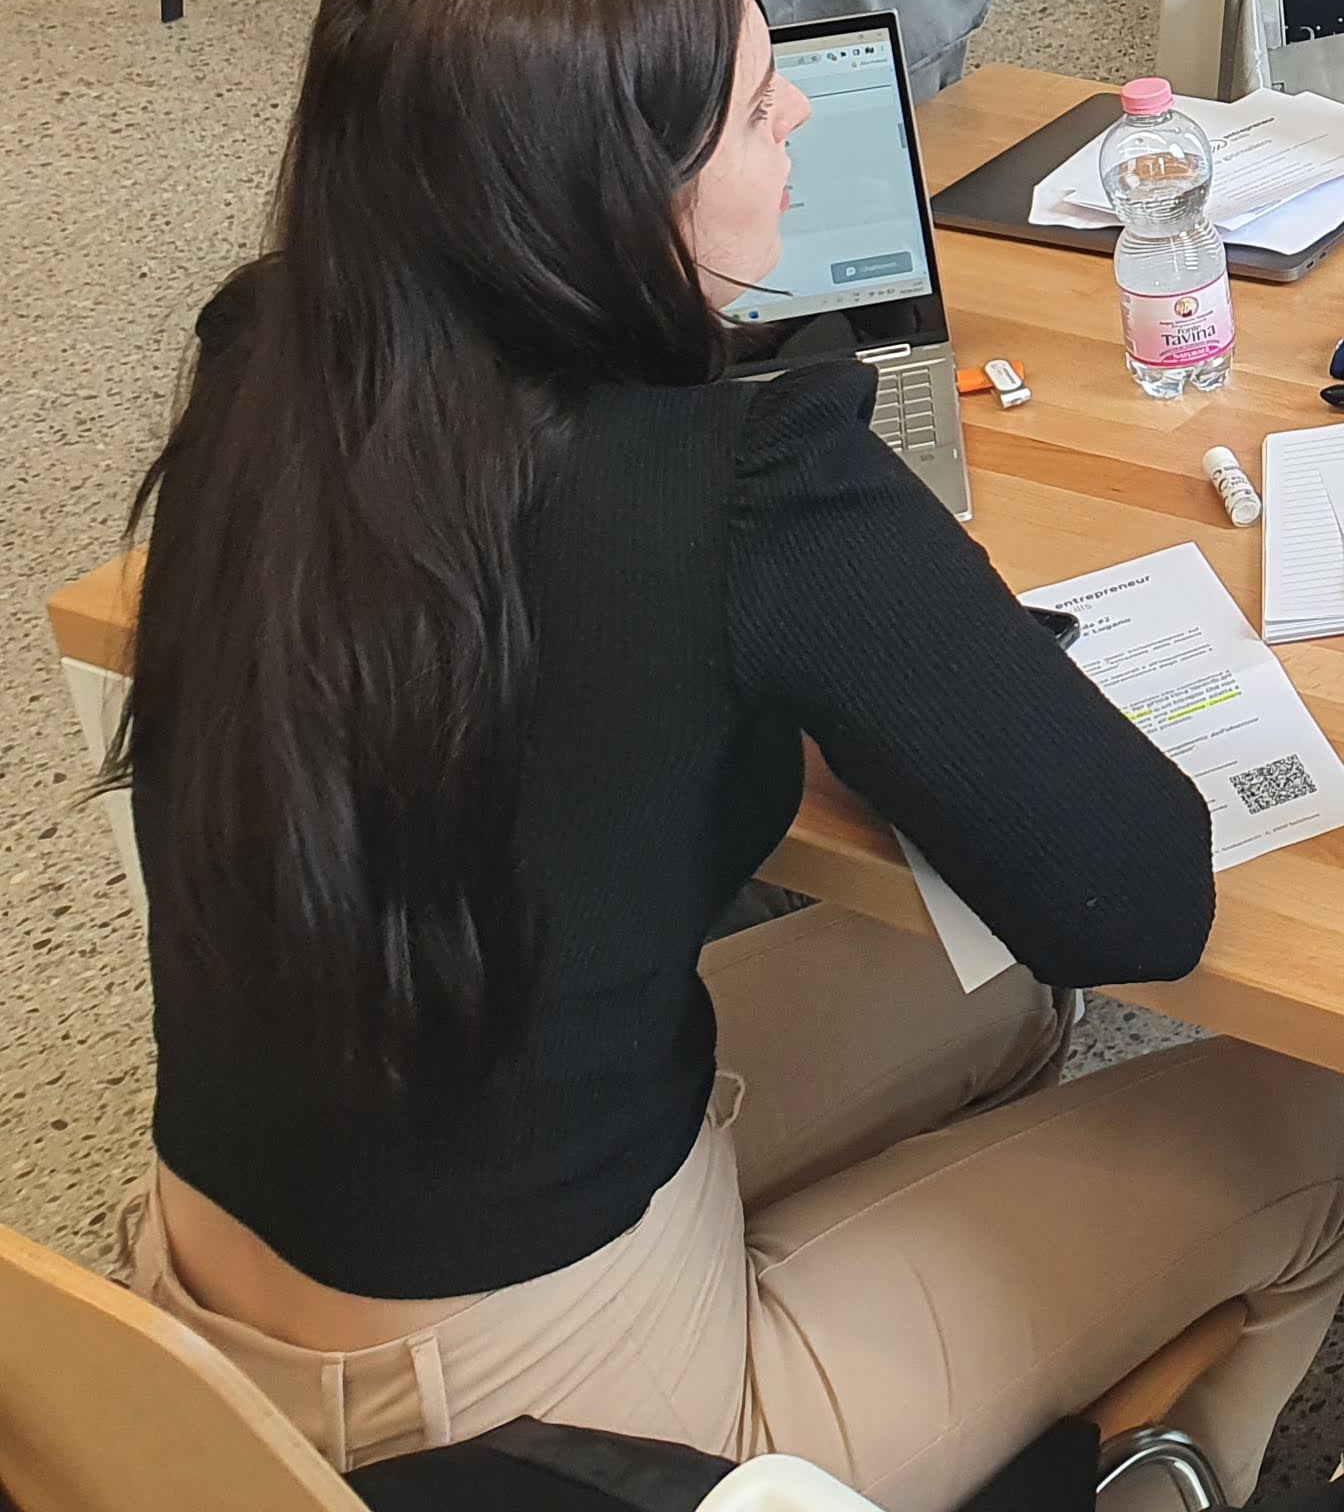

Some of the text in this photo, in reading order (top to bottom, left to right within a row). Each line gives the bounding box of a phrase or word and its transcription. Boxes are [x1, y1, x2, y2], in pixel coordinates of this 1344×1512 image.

[1160, 325, 1216, 346] Tavina
[1055, 575, 1151, 610] entrepreneur
[1092, 618, 1132, 635] Lugano
